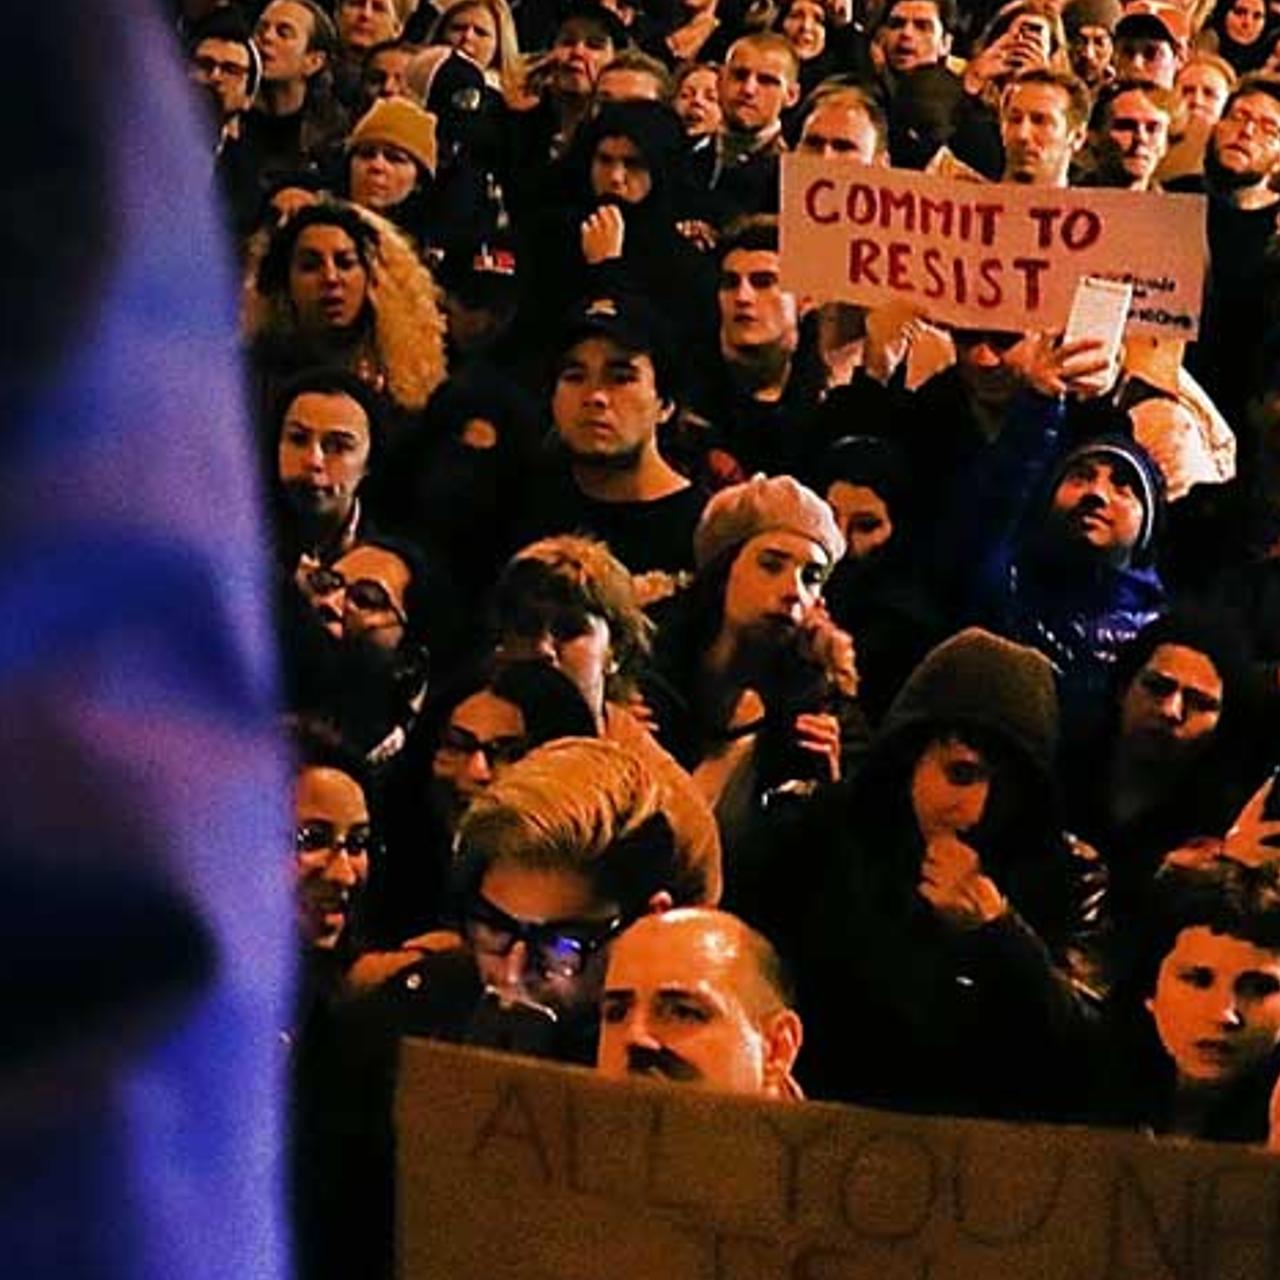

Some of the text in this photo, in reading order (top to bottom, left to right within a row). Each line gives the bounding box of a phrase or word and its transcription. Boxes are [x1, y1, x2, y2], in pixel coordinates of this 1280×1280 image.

[805, 179, 1102, 252] COMMIT TO
[849, 238, 1050, 313] RESIST
[468, 1080, 707, 1210] ALL
[761, 1112, 1070, 1249] YOU
